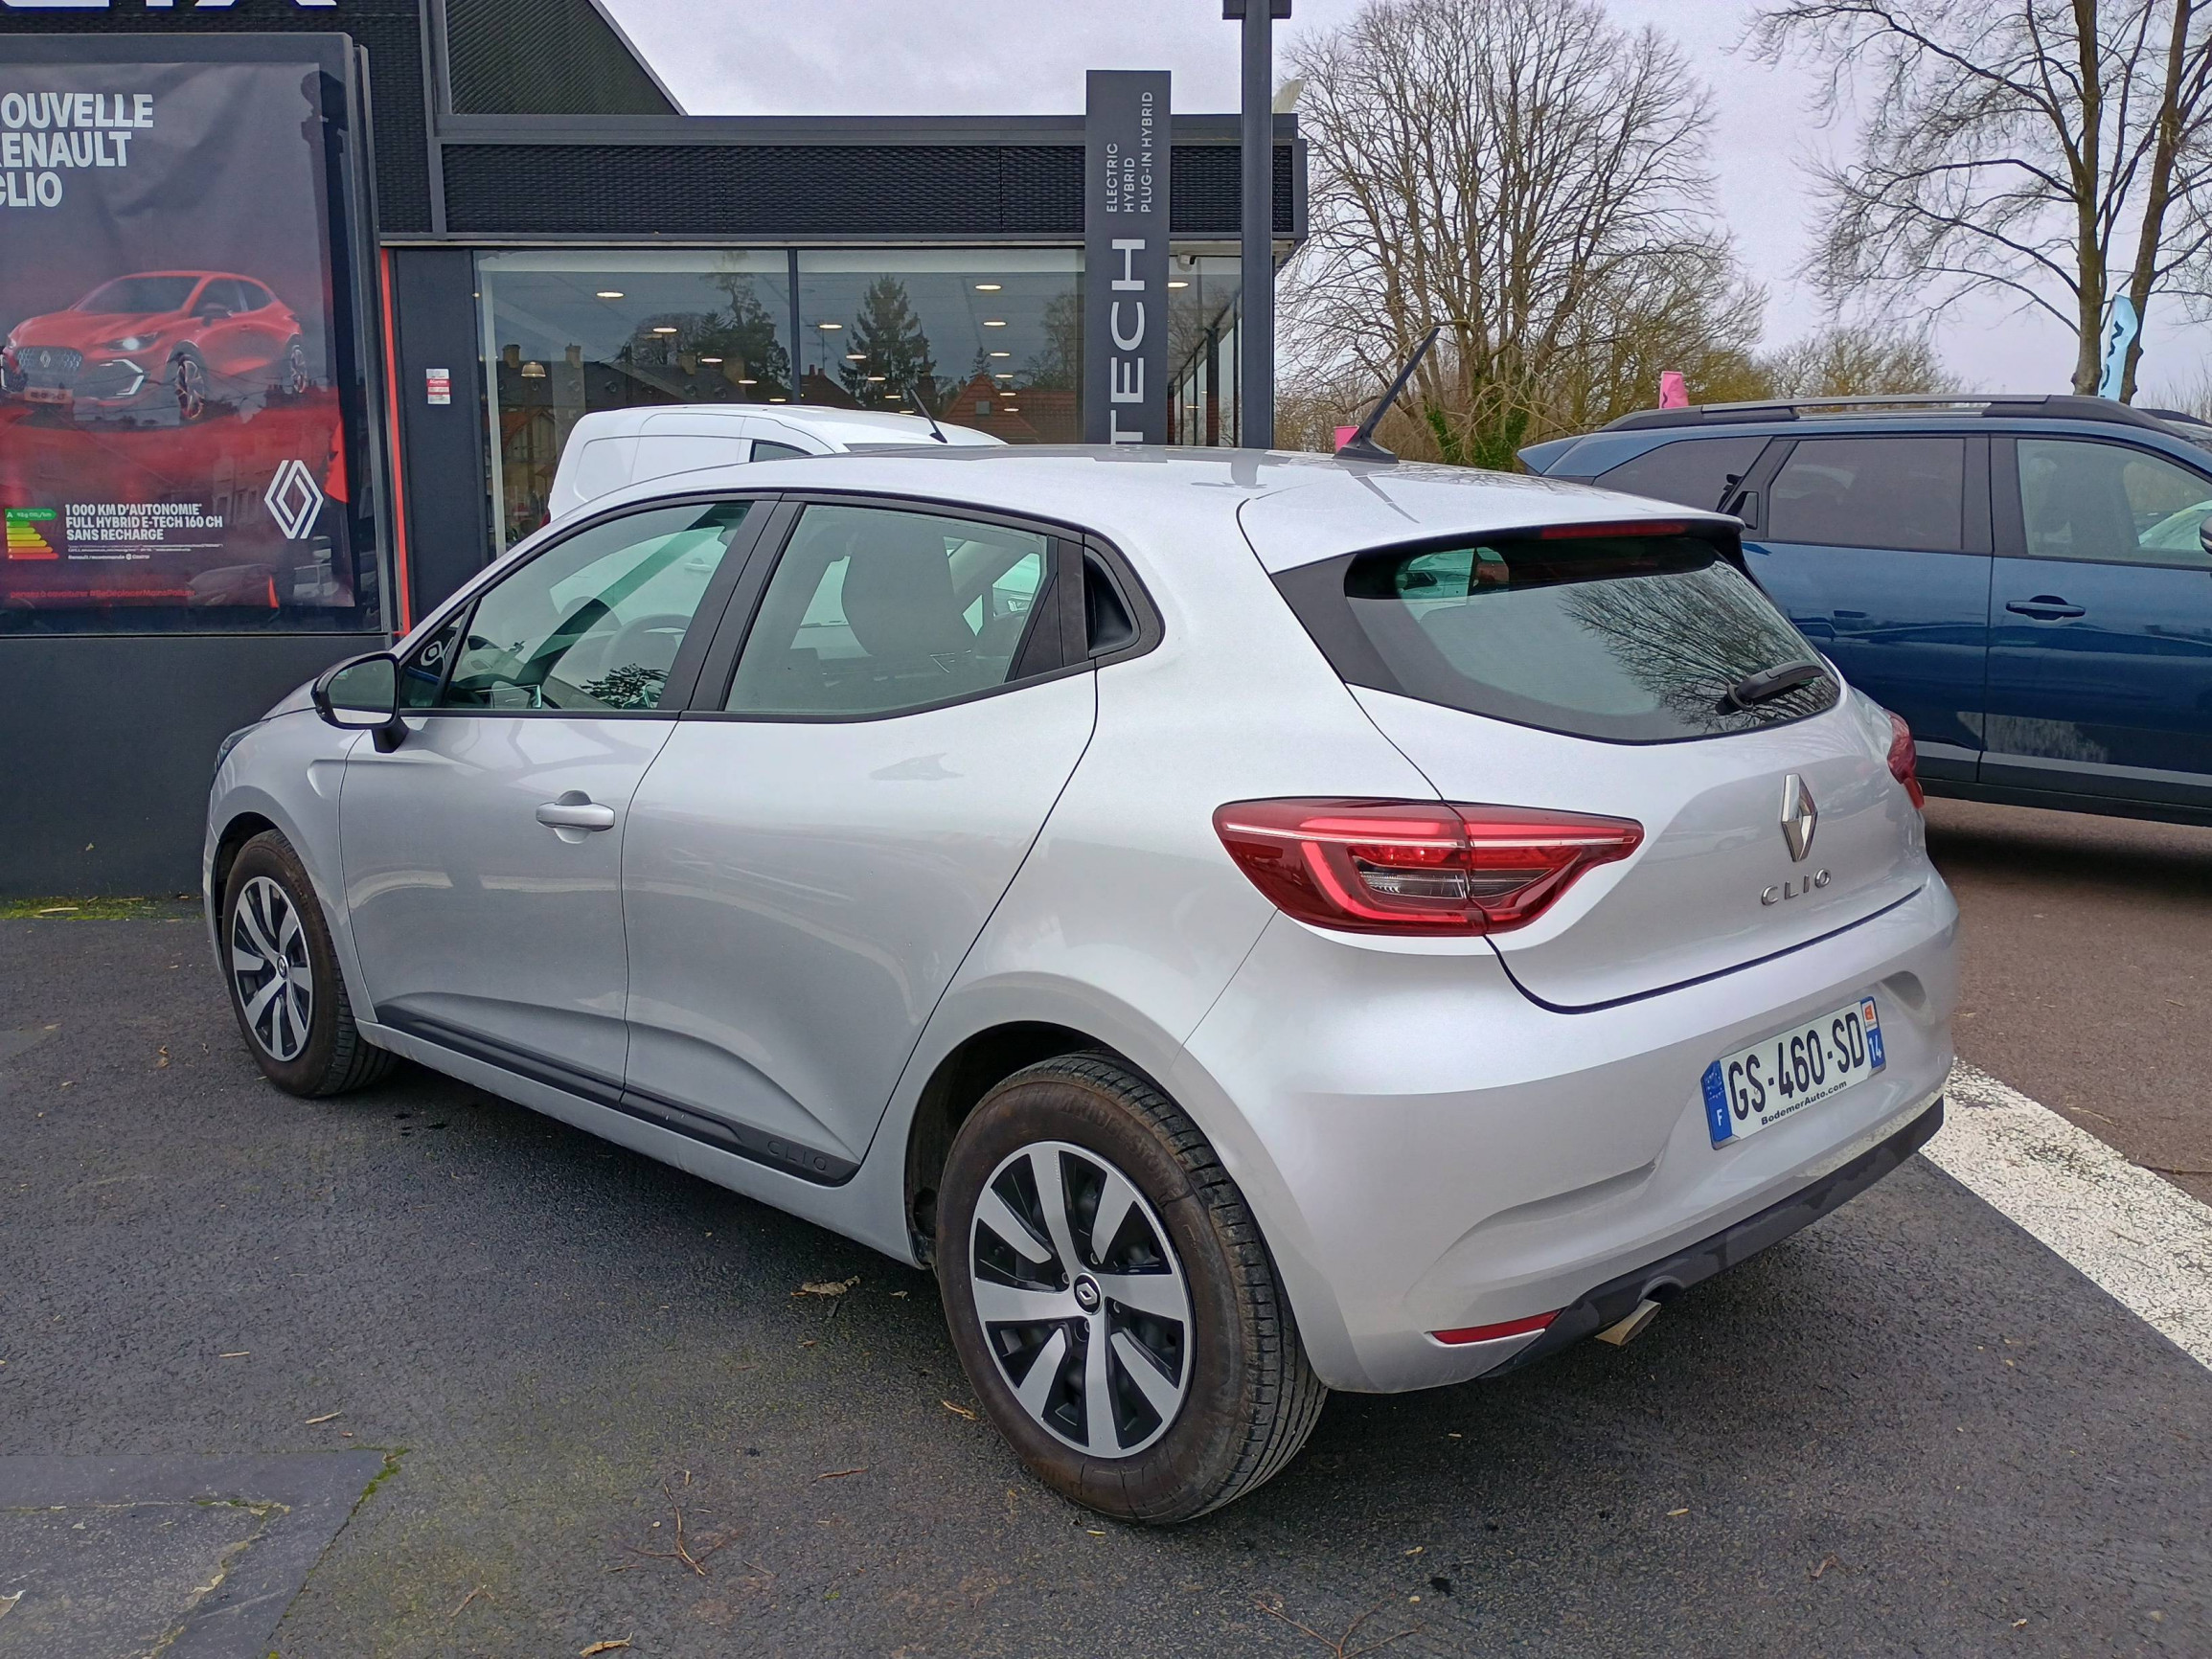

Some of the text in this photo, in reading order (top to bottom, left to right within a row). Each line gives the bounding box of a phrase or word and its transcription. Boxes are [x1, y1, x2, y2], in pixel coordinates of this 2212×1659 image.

[0, 130, 132, 168] ENAULT
[1140, 91, 1153, 213] PLUG-IN HYBRID
[0, 170, 63, 208] LIO
[1106, 143, 1118, 213] ELECTRIC
[1123, 157, 1135, 213] HYBRID
[65, 515, 223, 529] FULL HYBRID E-TECH 160 CH
[97, 503, 118, 516] KM
[66, 528, 164, 541] SANS RECHARGE
[1761, 867, 1832, 906] CLIO
[1716, 1011, 1882, 1127] F GS-460-SD 14
[1761, 1079, 1847, 1126] BodemerAuto.com
[766, 1140, 827, 1172] CLIO
